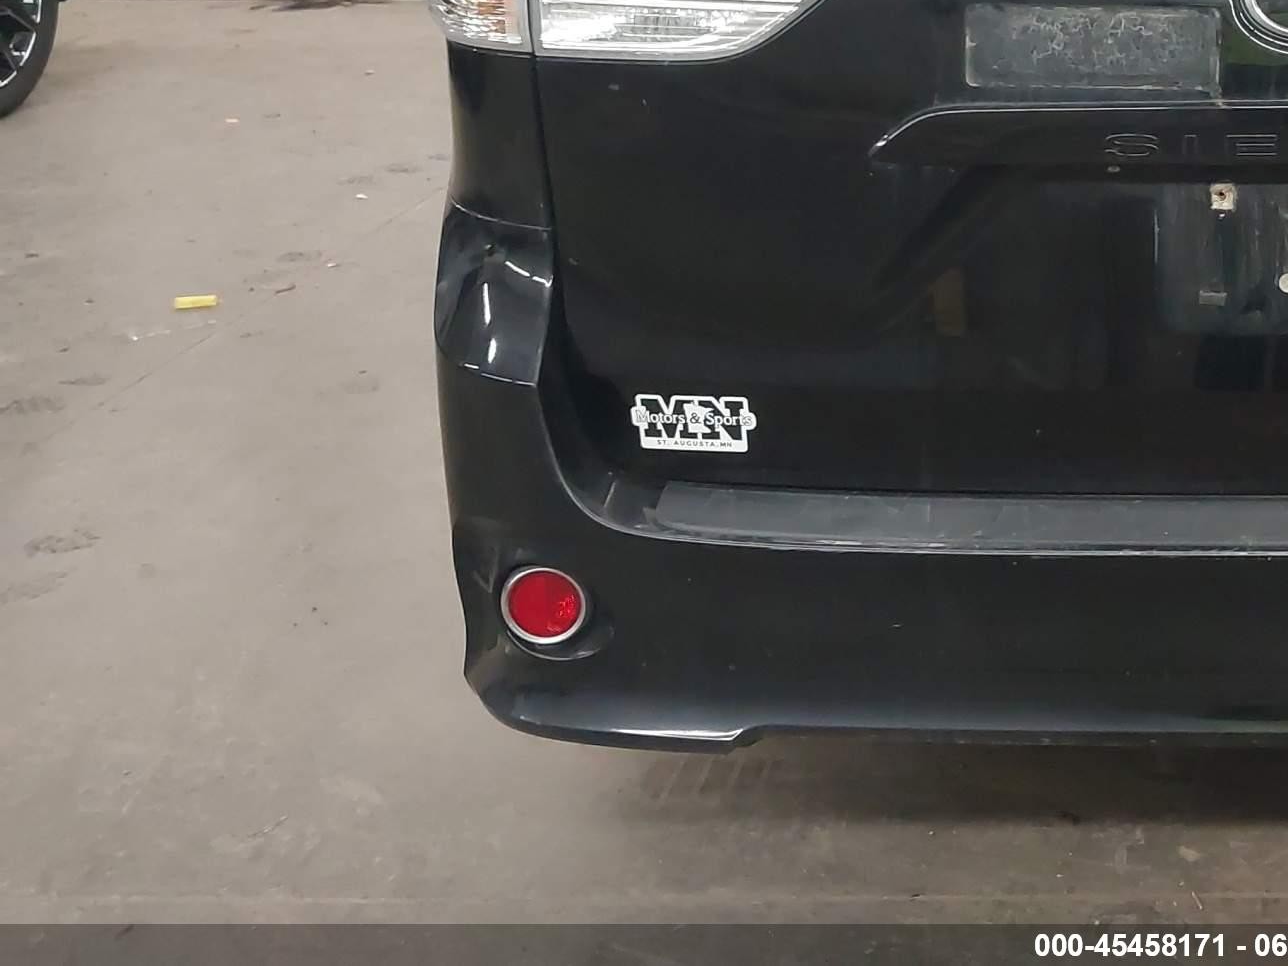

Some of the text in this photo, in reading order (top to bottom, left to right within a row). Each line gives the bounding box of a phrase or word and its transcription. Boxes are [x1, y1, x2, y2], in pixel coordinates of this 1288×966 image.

[635, 409, 753, 429] Motors & Sports
